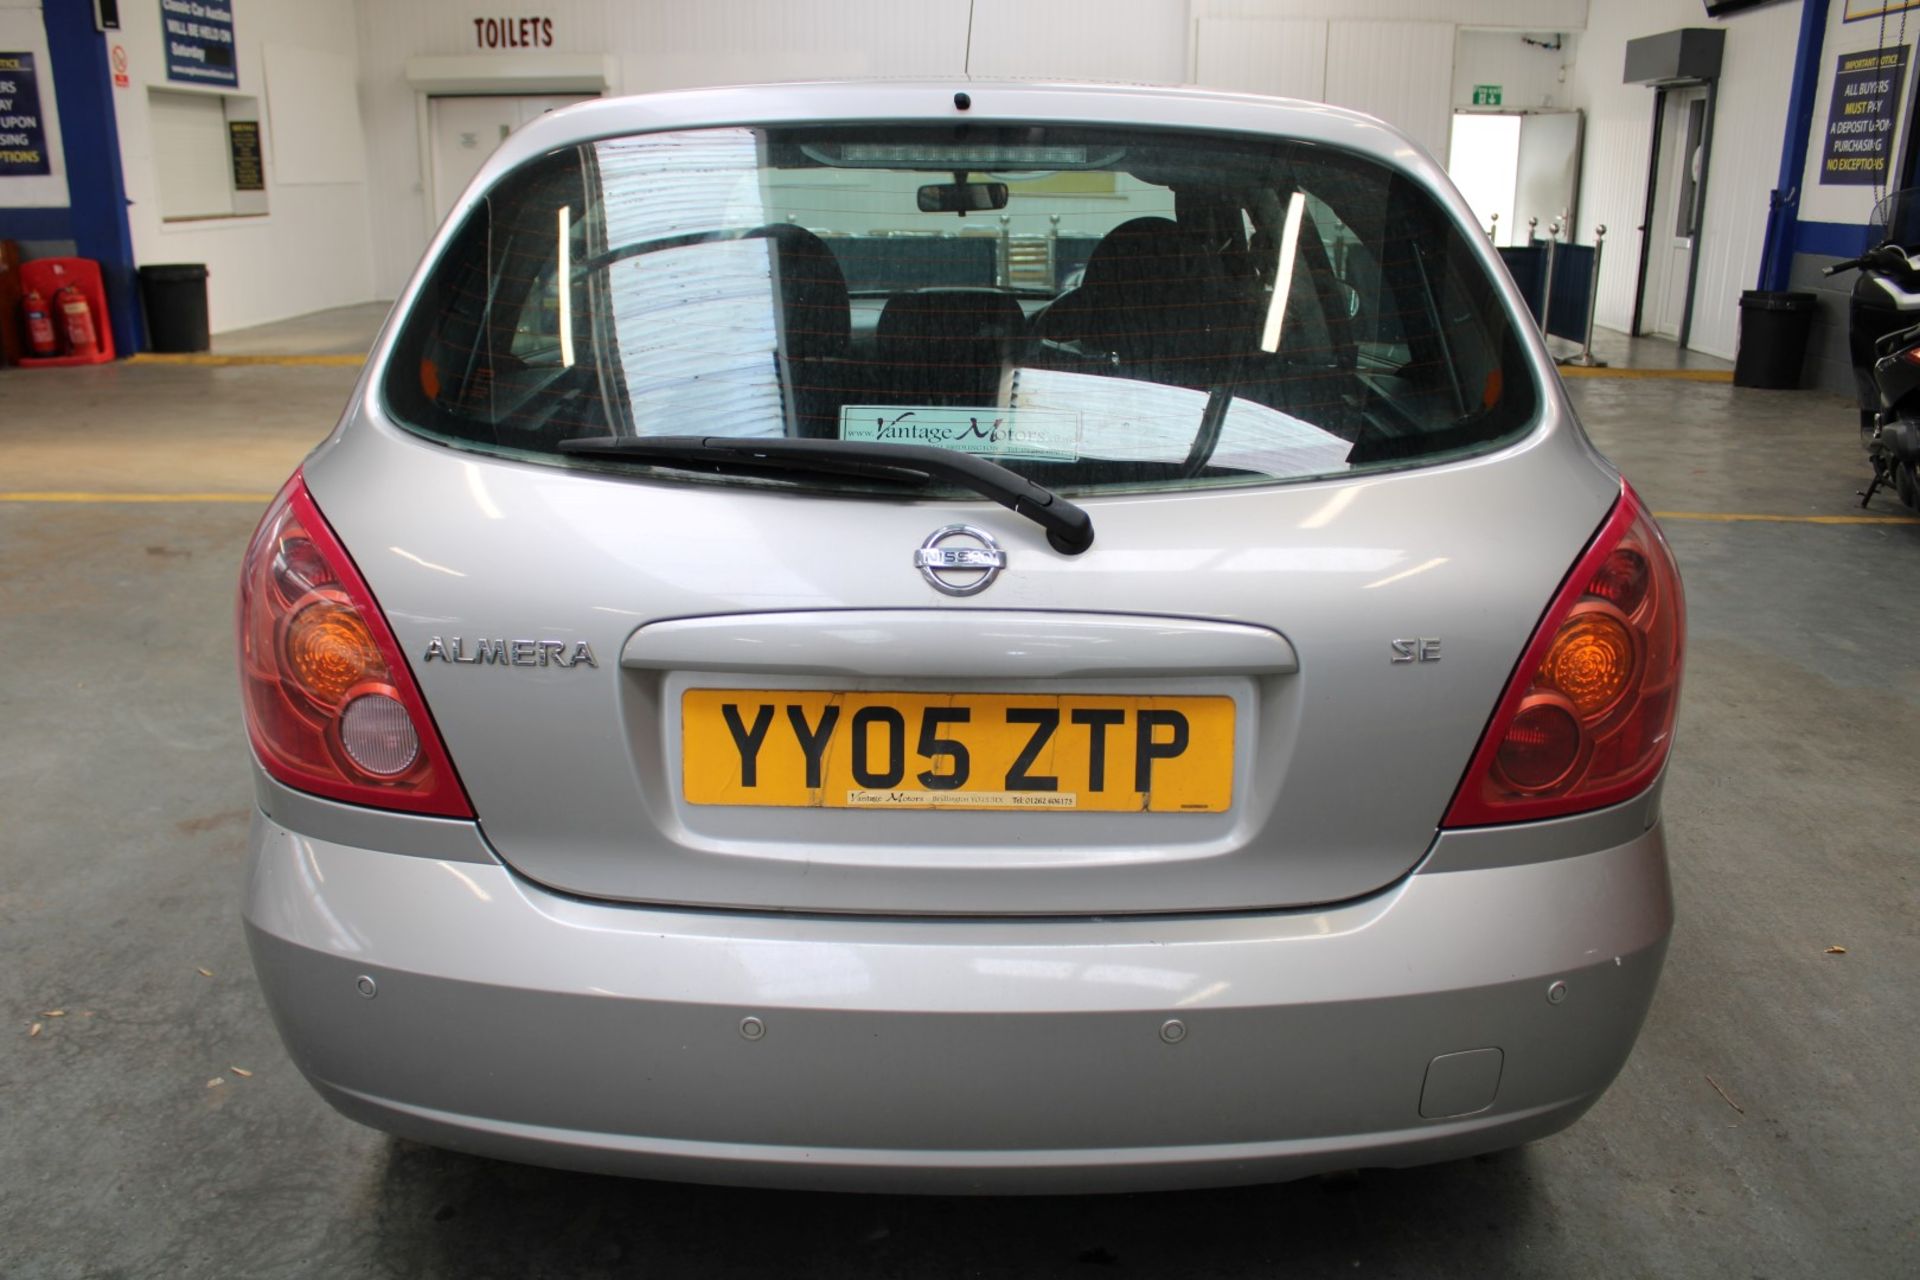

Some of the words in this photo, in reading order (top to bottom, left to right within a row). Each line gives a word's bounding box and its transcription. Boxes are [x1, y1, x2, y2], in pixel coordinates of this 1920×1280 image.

[474, 17, 553, 48] TOILETS
[1844, 83, 1858, 97] ALL
[1844, 101, 1867, 115] MUST
[1, 116, 37, 128] UPON
[1830, 122, 1836, 134] A
[1836, 120, 1868, 134] DEPOSIT
[1827, 158, 1838, 171] NO
[922, 549, 999, 565] NISSAN
[424, 635, 599, 668] ALMERA
[1391, 637, 1441, 664] SE
[721, 704, 971, 790] YY05
[1005, 708, 1189, 792] ZTP
